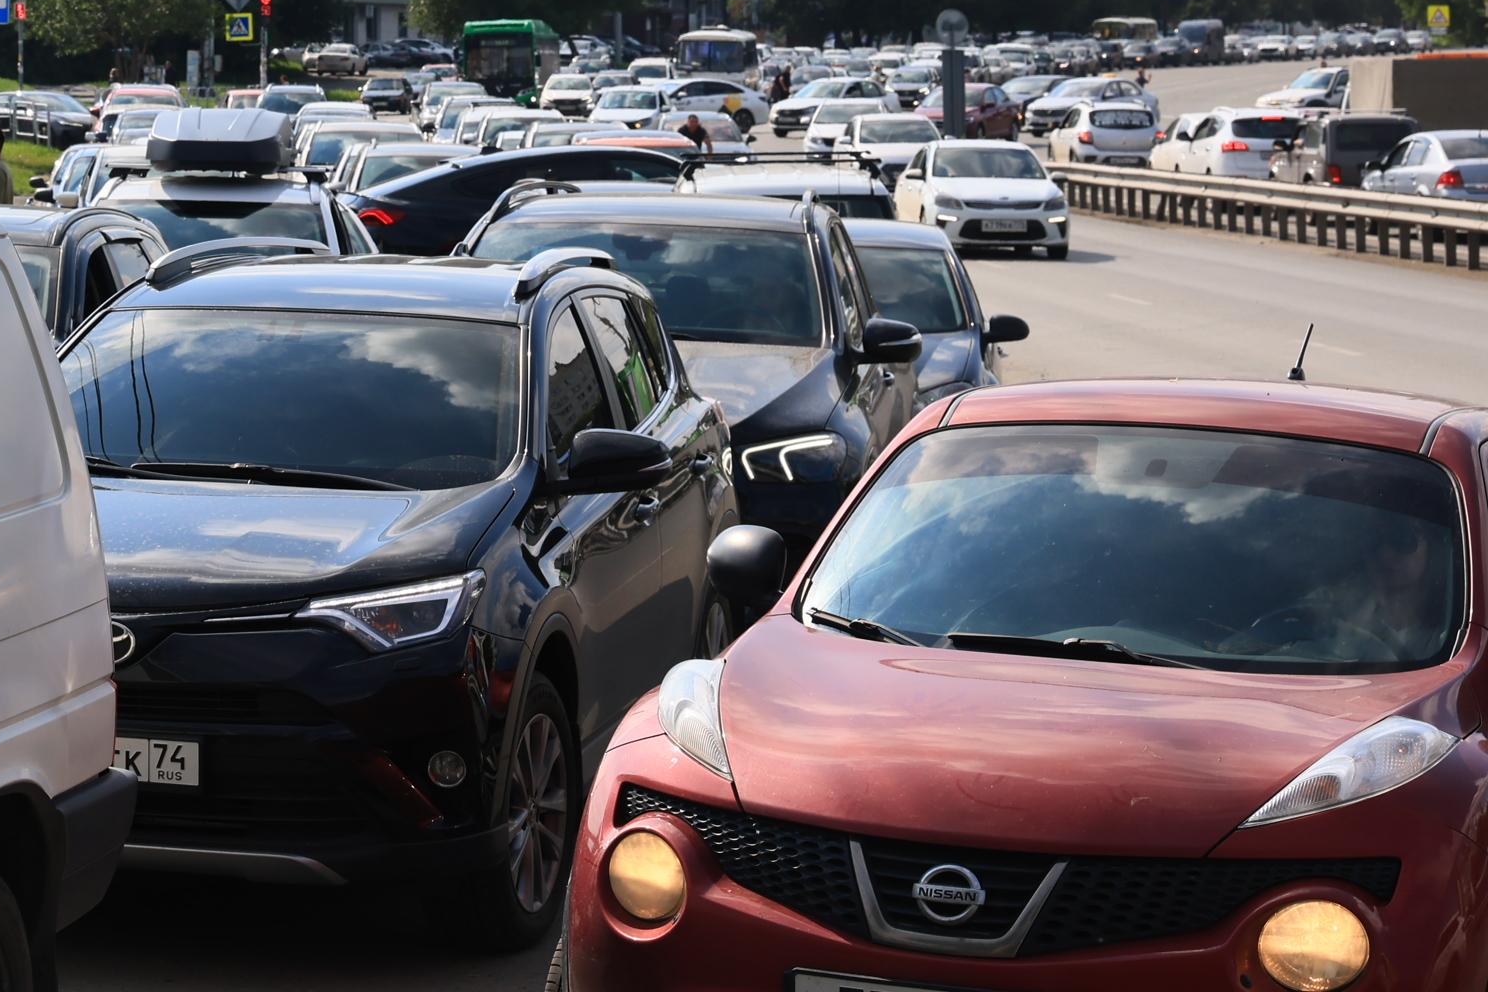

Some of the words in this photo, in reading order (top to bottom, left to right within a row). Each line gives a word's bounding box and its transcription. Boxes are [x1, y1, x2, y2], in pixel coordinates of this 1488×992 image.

[153, 743, 185, 771] 74
[157, 770, 183, 781] RUS
[918, 887, 977, 902] NISSAN
